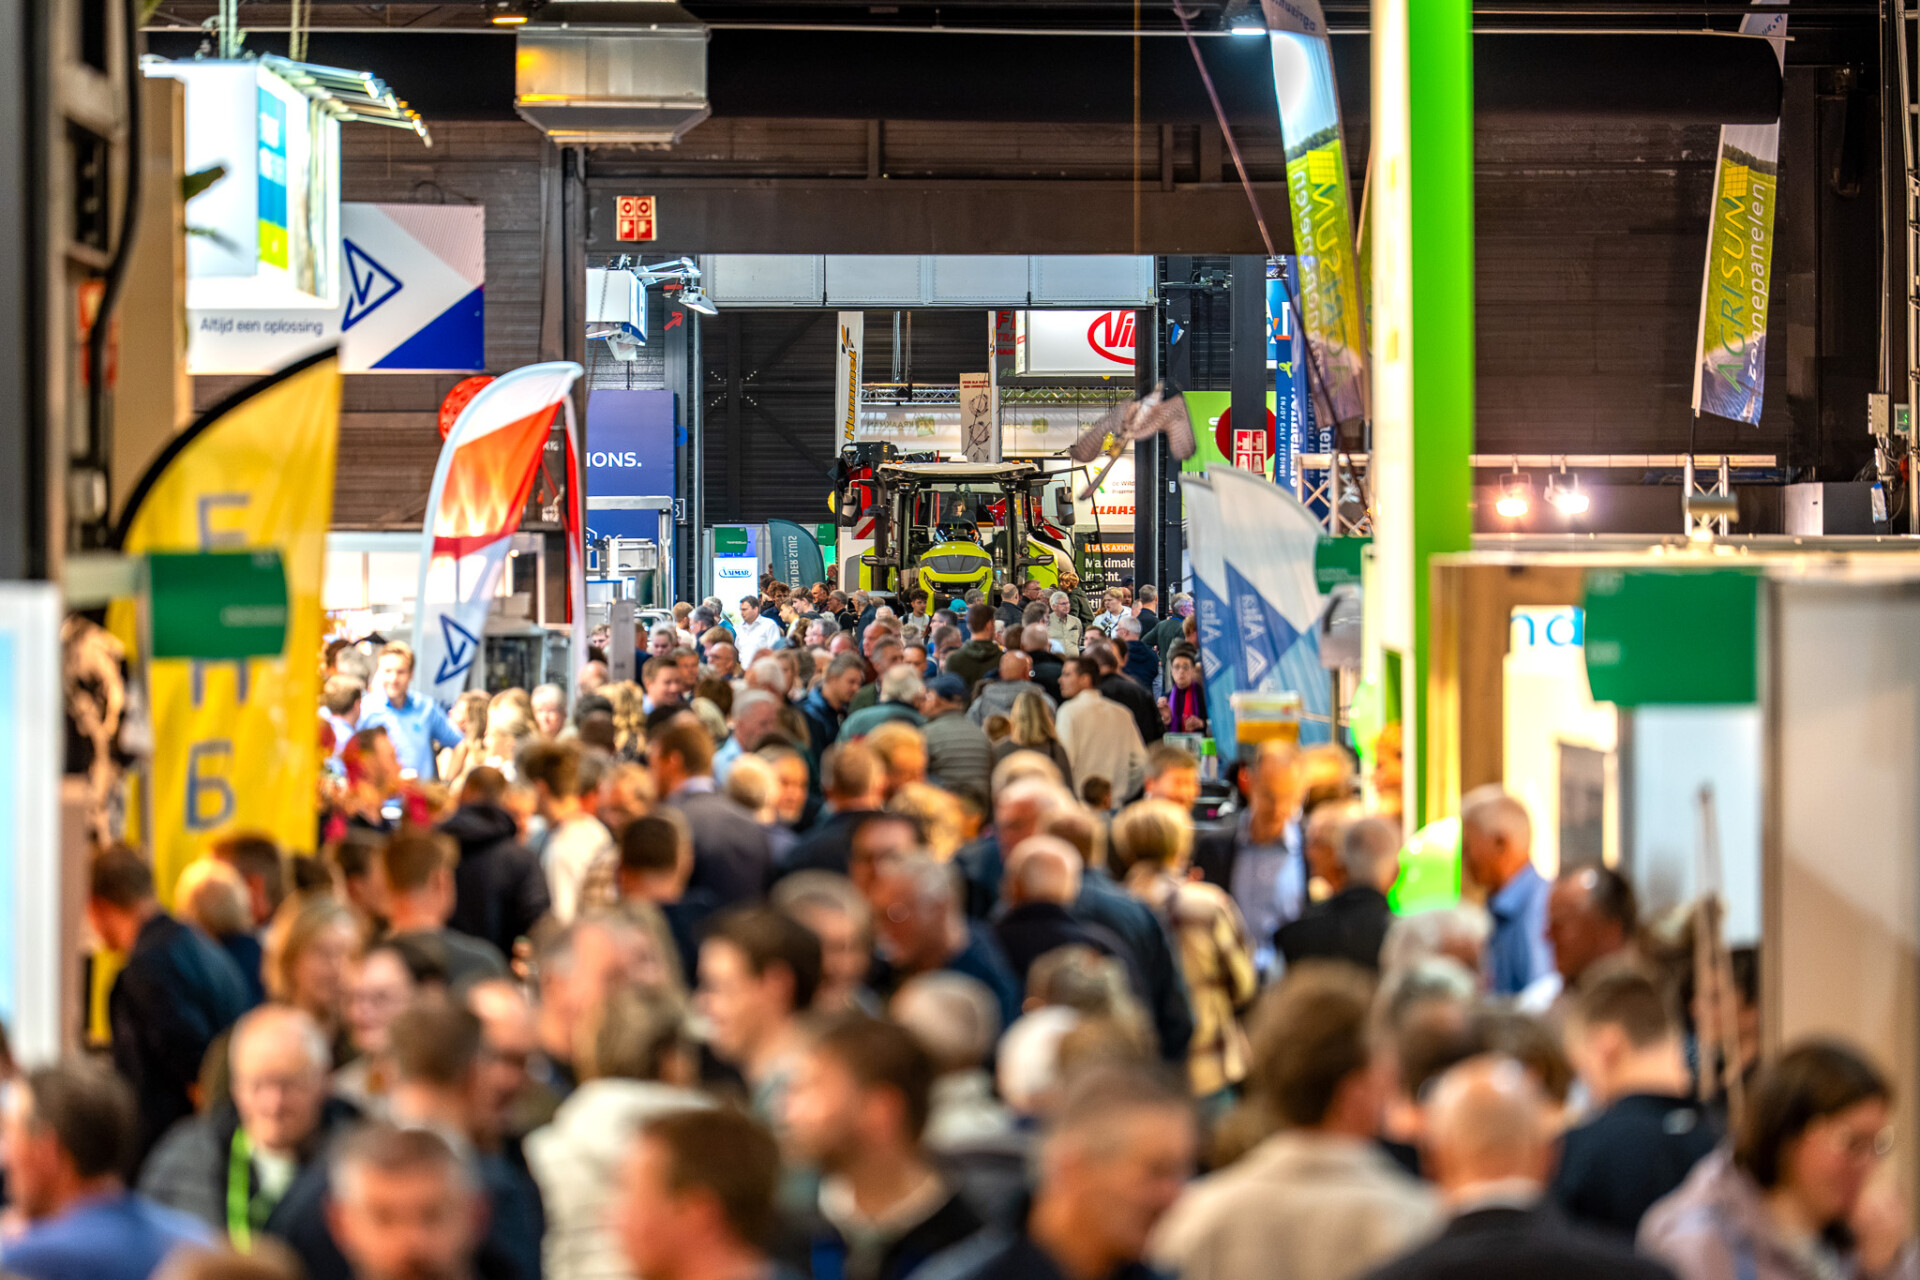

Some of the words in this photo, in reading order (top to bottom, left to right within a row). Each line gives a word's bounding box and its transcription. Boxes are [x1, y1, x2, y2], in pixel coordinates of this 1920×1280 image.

[1717, 194, 1746, 393] AGRISUN
[200, 317, 234, 334] Altijd
[237, 320, 260, 333] een
[263, 318, 324, 337] oplossing
[844, 349, 857, 441] Hummel
[1090, 505, 1136, 515] CLAAS
[1112, 544, 1134, 552] AXION
